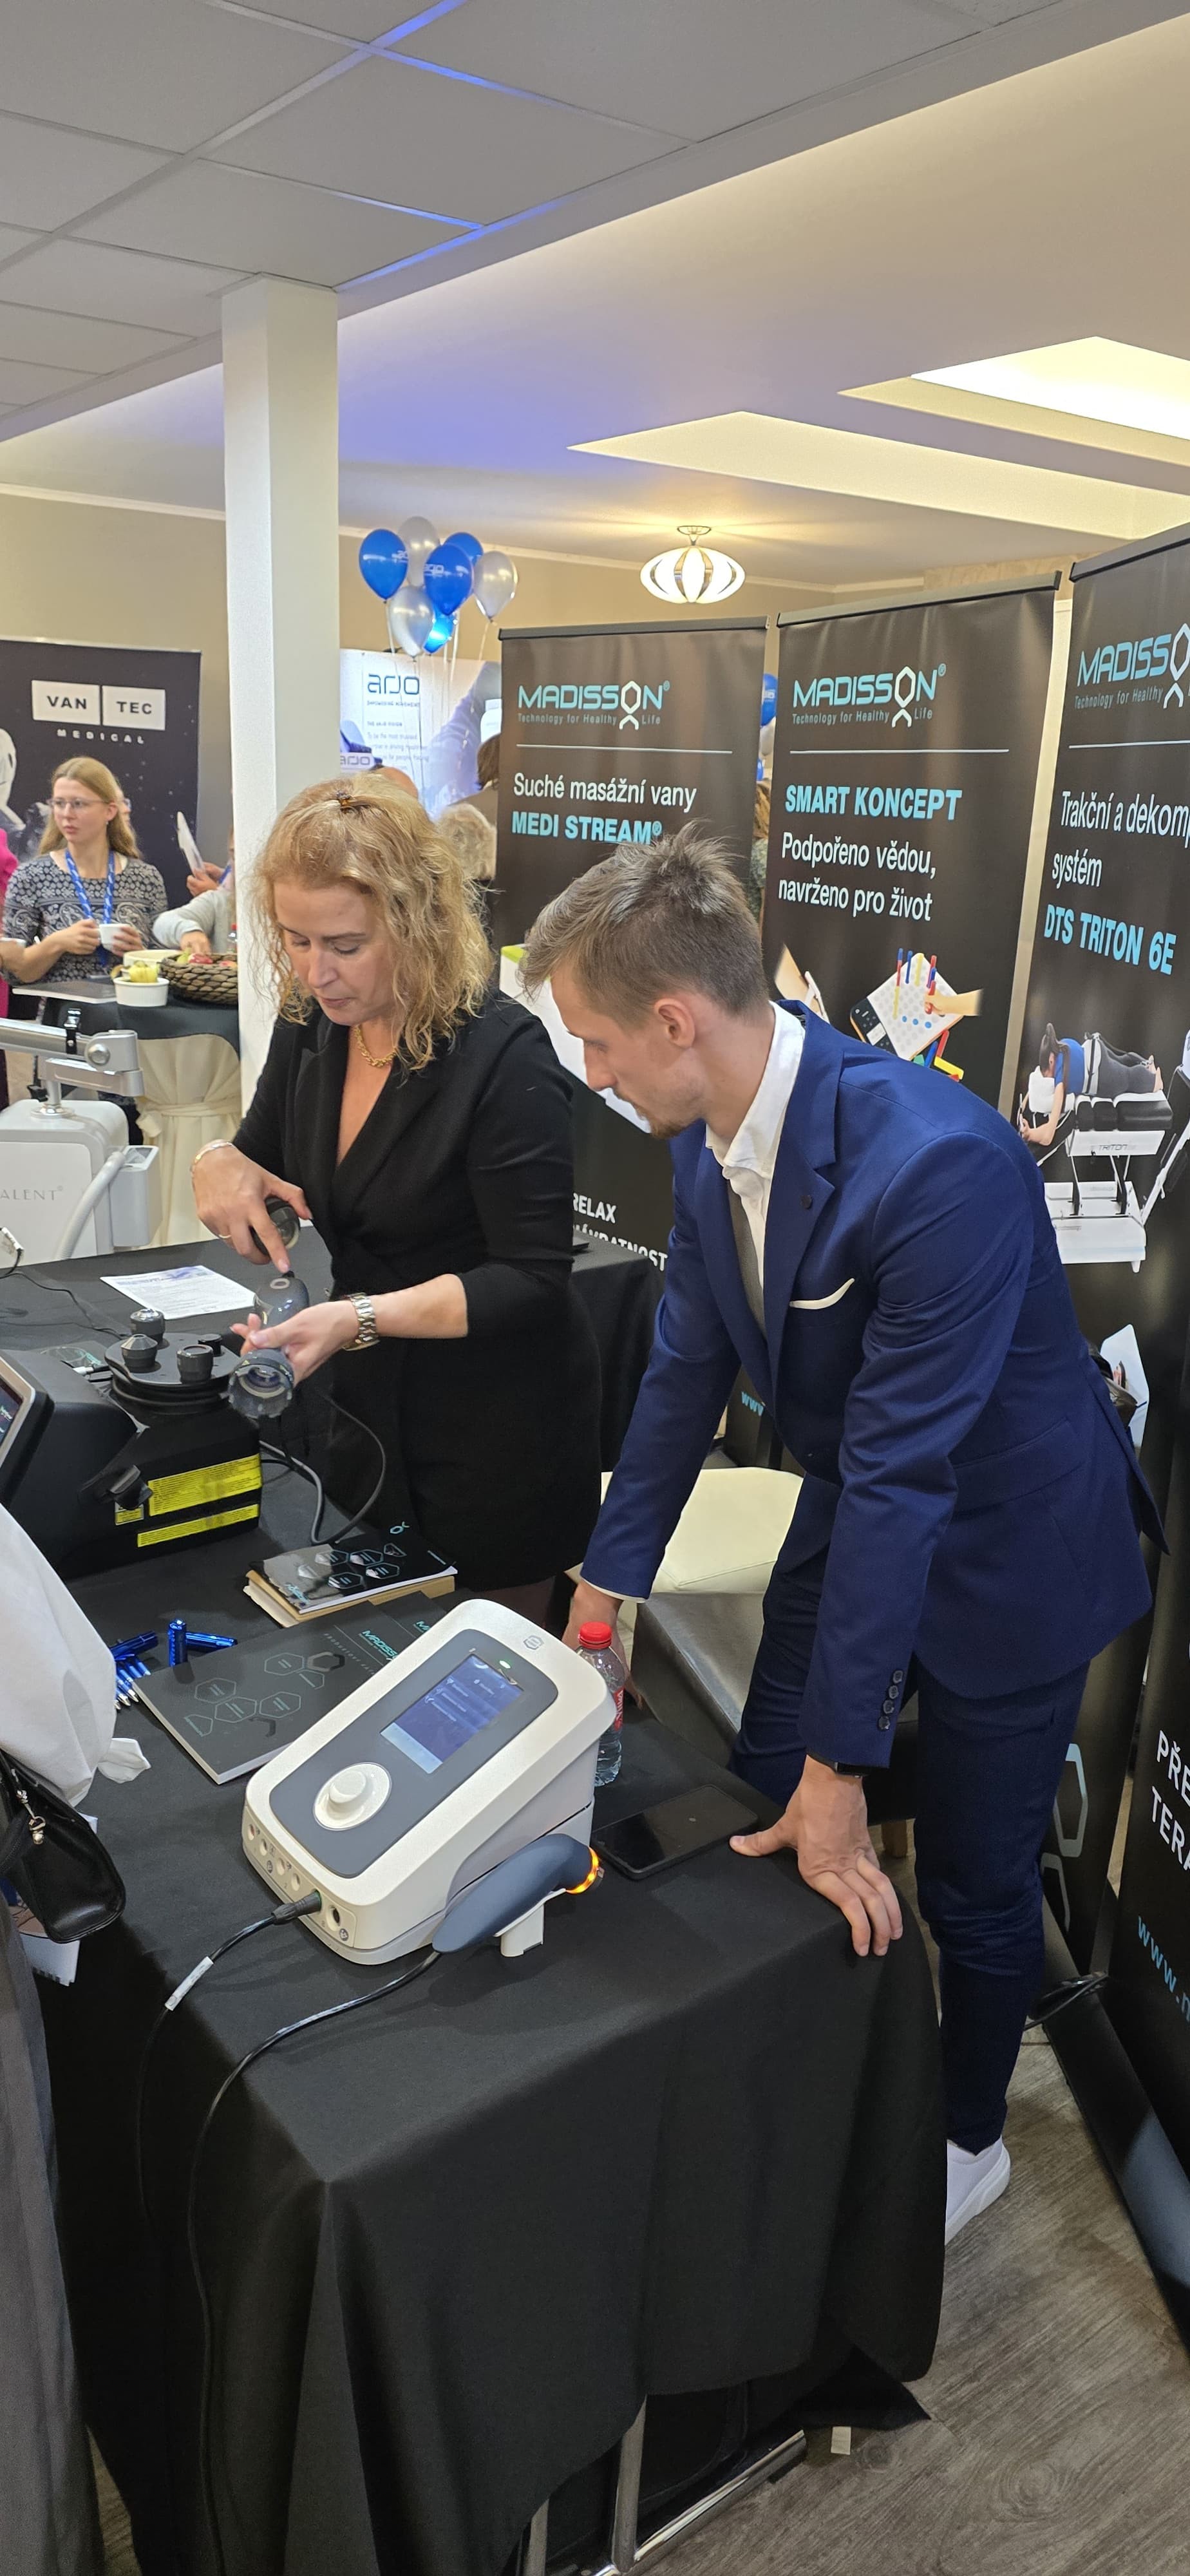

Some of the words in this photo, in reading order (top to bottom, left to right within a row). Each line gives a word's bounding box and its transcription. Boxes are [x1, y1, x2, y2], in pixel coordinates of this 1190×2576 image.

[46, 695, 88, 710] VAN
[116, 700, 153, 715] TEC
[1075, 693, 1114, 709] Technology
[1117, 690, 1130, 705] for
[1131, 685, 1164, 704] Healthy
[518, 712, 563, 725] Technology
[567, 714, 580, 724] for
[583, 714, 617, 726] Healthy
[641, 714, 661, 725] Life
[792, 712, 837, 725] Technology
[840, 710, 853, 723] for
[856, 709, 890, 724] Healthy
[914, 707, 933, 720] Life
[57, 729, 145, 744] MEDICAL
[513, 772, 565, 799] Suché
[570, 777, 647, 804] masážní
[650, 785, 697, 813] vany
[785, 784, 851, 815] SMART
[854, 786, 963, 821] KONCEPT
[511, 812, 559, 838] MEDI
[1061, 791, 1114, 831] Trakční
[1113, 802, 1124, 831] a
[781, 831, 870, 868] Podpořeno
[876, 839, 936, 880] vědou,
[1052, 848, 1102, 890] systém
[778, 876, 849, 909] navrženo
[853, 889, 885, 918] pro
[889, 886, 933, 922] život
[1044, 904, 1075, 945] DTS
[1079, 911, 1144, 965] TRITON
[1148, 931, 1176, 976] 6E
[573, 1193, 617, 1224] RELAX
